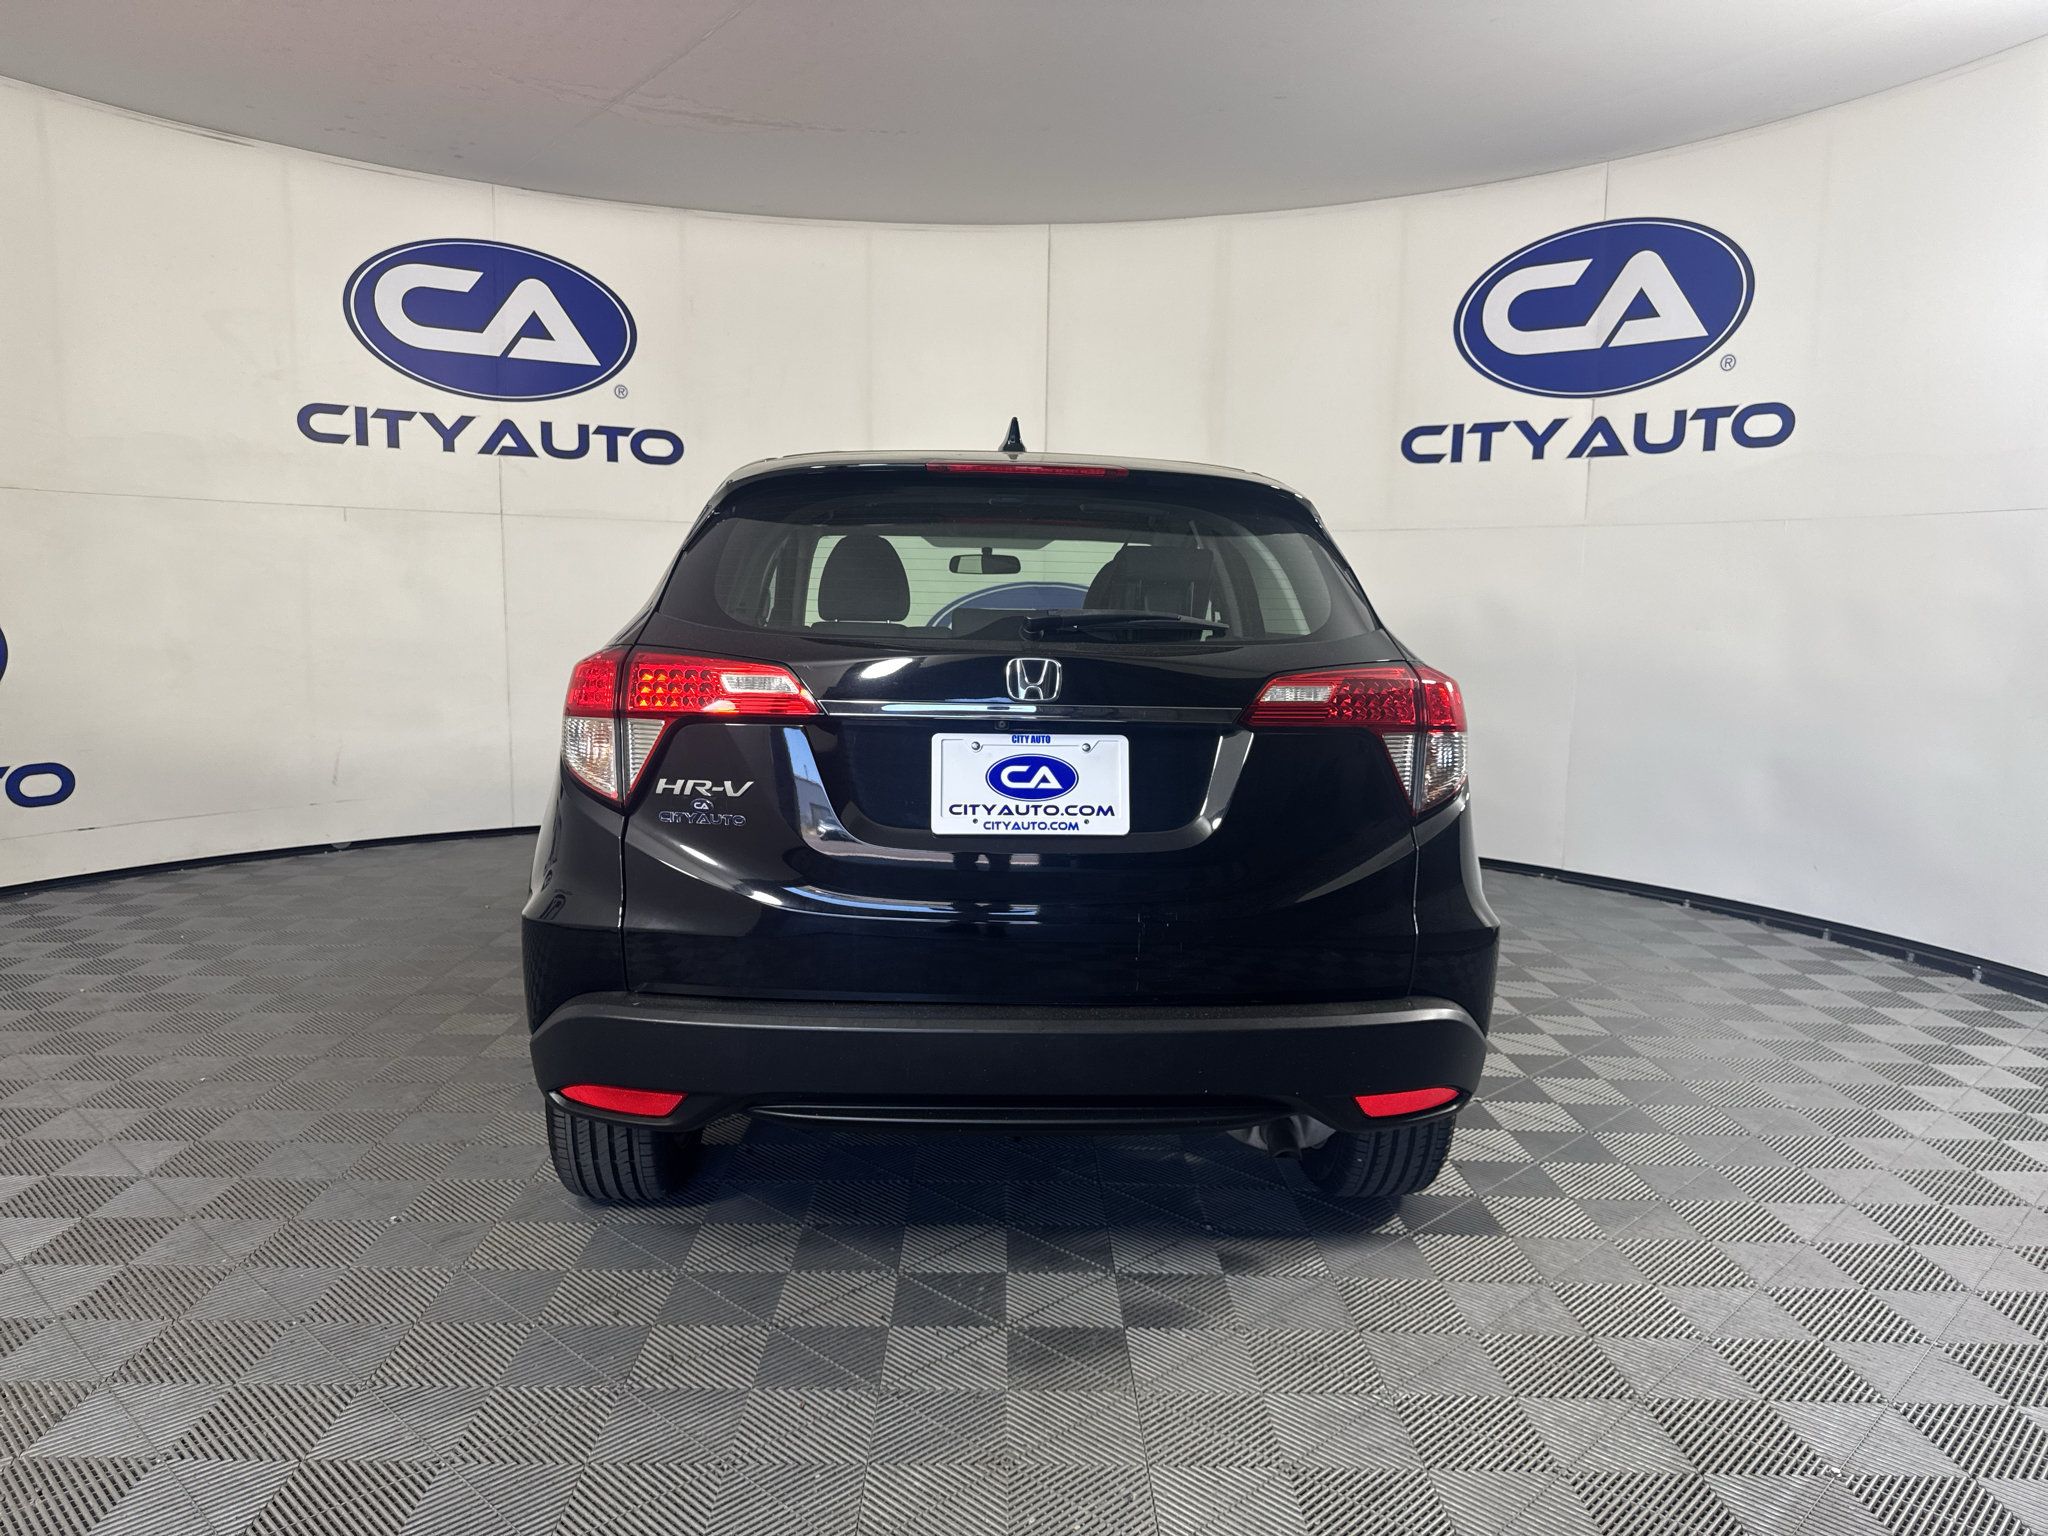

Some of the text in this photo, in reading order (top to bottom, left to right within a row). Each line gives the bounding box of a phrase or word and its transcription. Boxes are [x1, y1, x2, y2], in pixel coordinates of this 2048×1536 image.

[1482, 249, 1709, 356] CA
[374, 263, 601, 366] CA
[1011, 735, 1051, 744] CITY AUTO
[1001, 765, 1063, 789] CA
[655, 778, 755, 797] HR-V
[693, 802, 709, 810] CA
[949, 804, 1116, 817] CITYAUTO.COM
[983, 821, 1080, 831] CITYAUTO.COM
